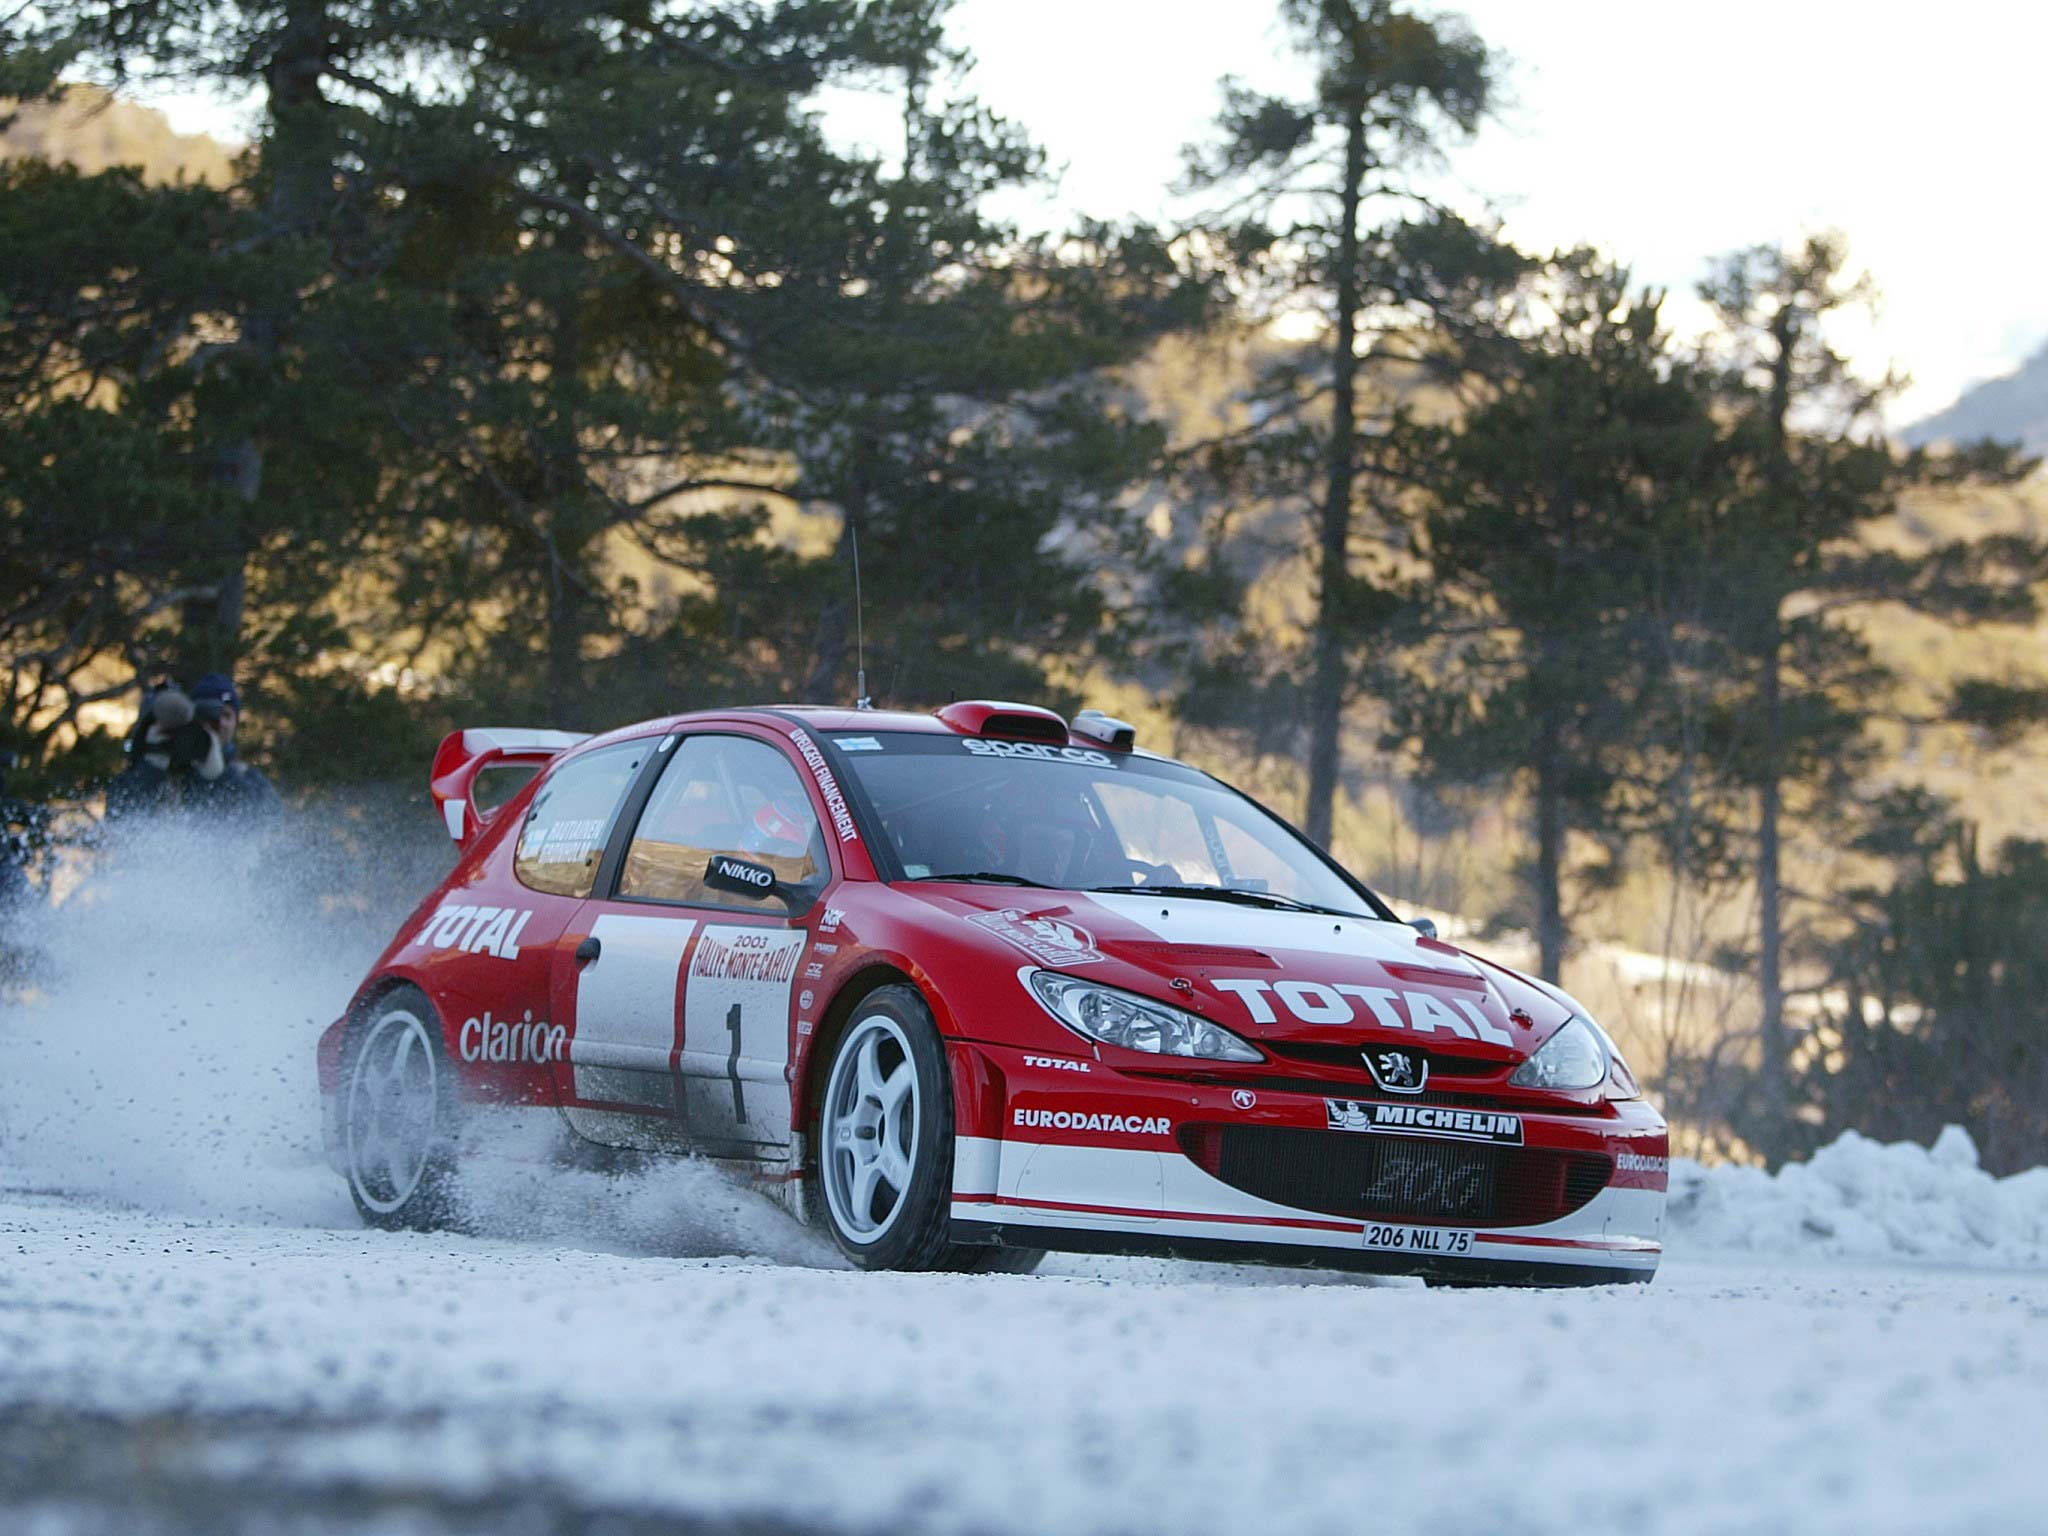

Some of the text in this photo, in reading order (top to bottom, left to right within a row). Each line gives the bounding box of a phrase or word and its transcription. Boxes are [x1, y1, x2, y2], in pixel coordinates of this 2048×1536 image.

[961, 738, 1112, 766] sparco
[795, 732, 857, 842] PEUGEOT FINANCEMENT
[718, 861, 773, 887] NIKKO
[821, 909, 846, 926] NGK
[416, 905, 533, 961] TOTAL
[733, 935, 769, 949] 2003
[692, 935, 729, 979] RALLYE
[1211, 979, 1514, 1048] TOTAL
[459, 1009, 567, 1064] Clarion
[726, 1003, 748, 1125] 1
[1023, 1055, 1091, 1073] TOTAL
[1013, 1108, 1171, 1135] EURODATACAR
[1375, 1105, 1518, 1135] MICHELIN
[1368, 1226, 1468, 1252] 206 NLL 75
